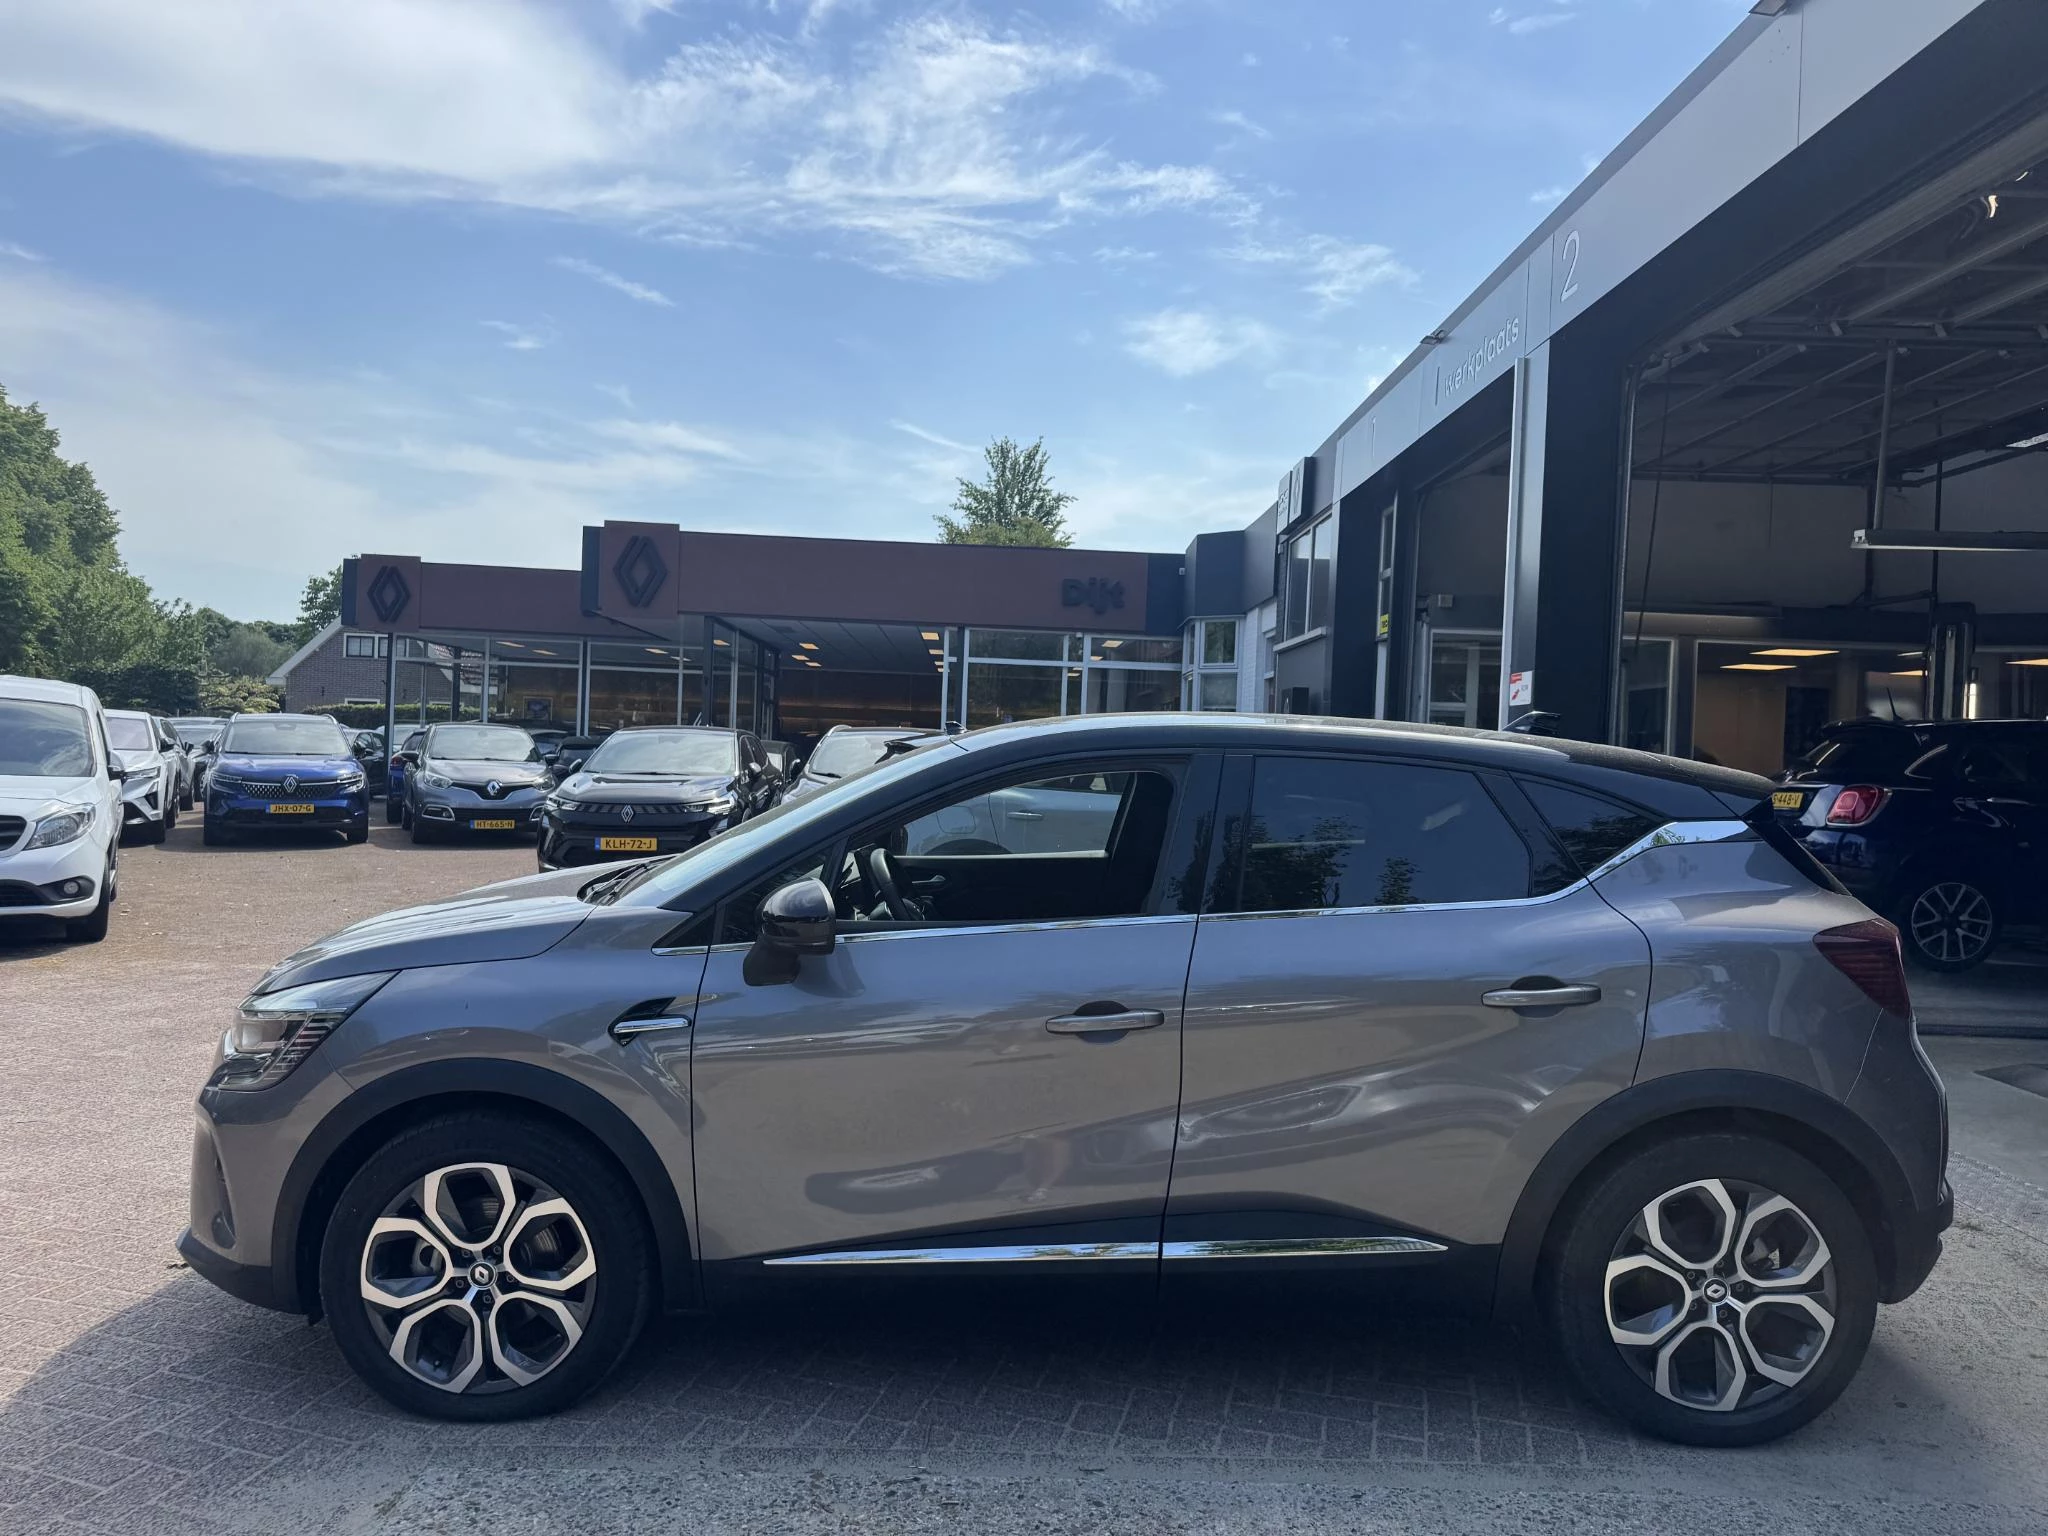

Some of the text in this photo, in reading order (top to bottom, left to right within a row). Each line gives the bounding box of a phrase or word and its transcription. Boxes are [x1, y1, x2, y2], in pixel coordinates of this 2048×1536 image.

[1560, 230, 1580, 302] 2
[1444, 317, 1519, 397] werkplaats
[605, 839, 652, 849] KLH-72-J
